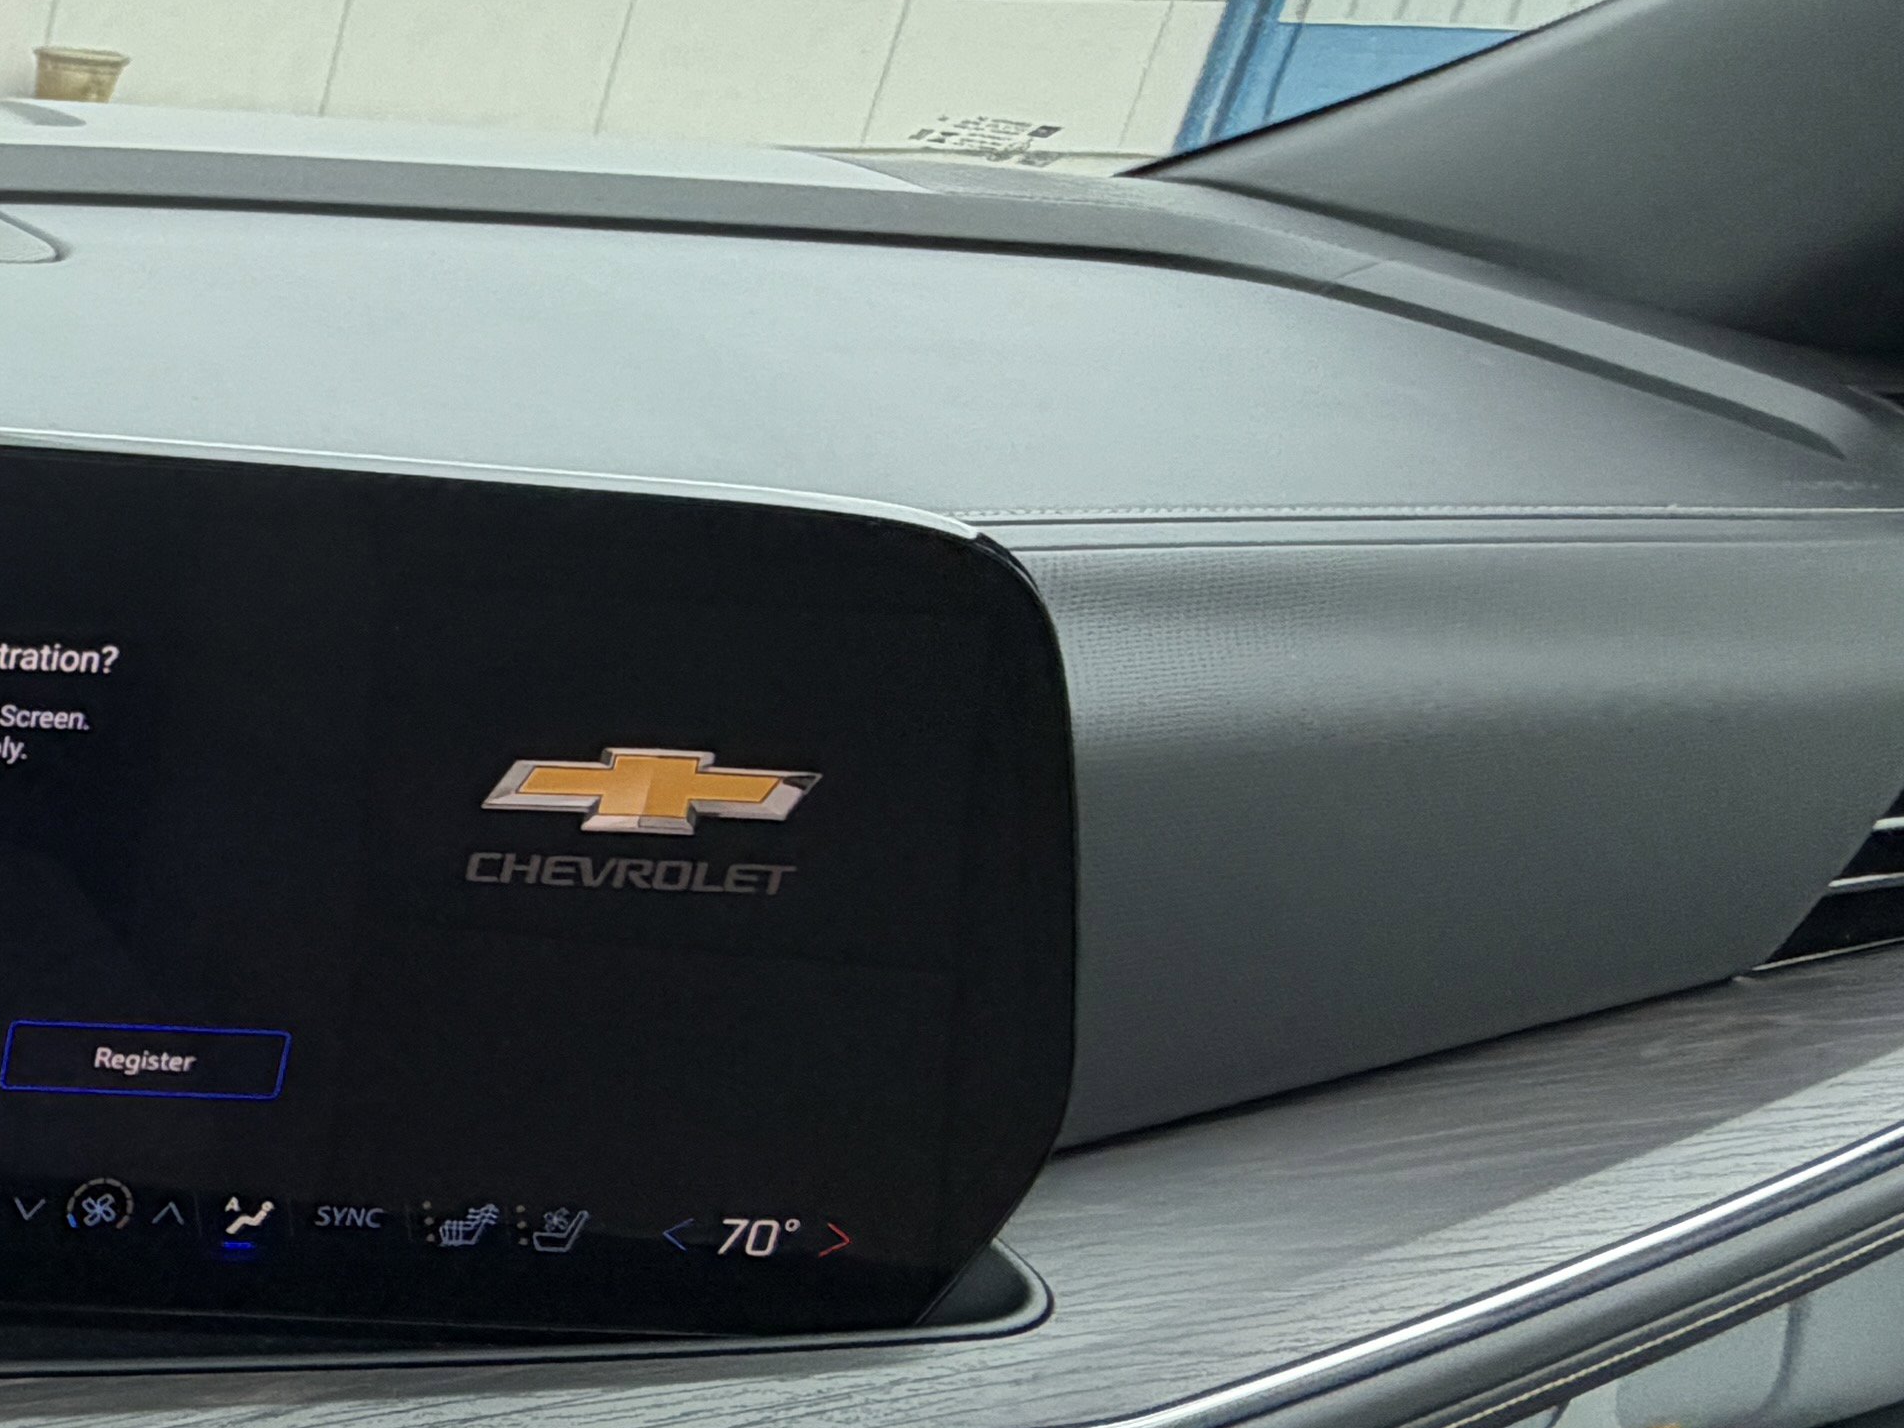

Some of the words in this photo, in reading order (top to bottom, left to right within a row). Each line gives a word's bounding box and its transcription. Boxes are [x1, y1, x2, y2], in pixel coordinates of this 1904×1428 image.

[465, 852, 797, 896] CHEVROLET
[94, 1046, 196, 1076] Register
[315, 1205, 384, 1229] SYNC
